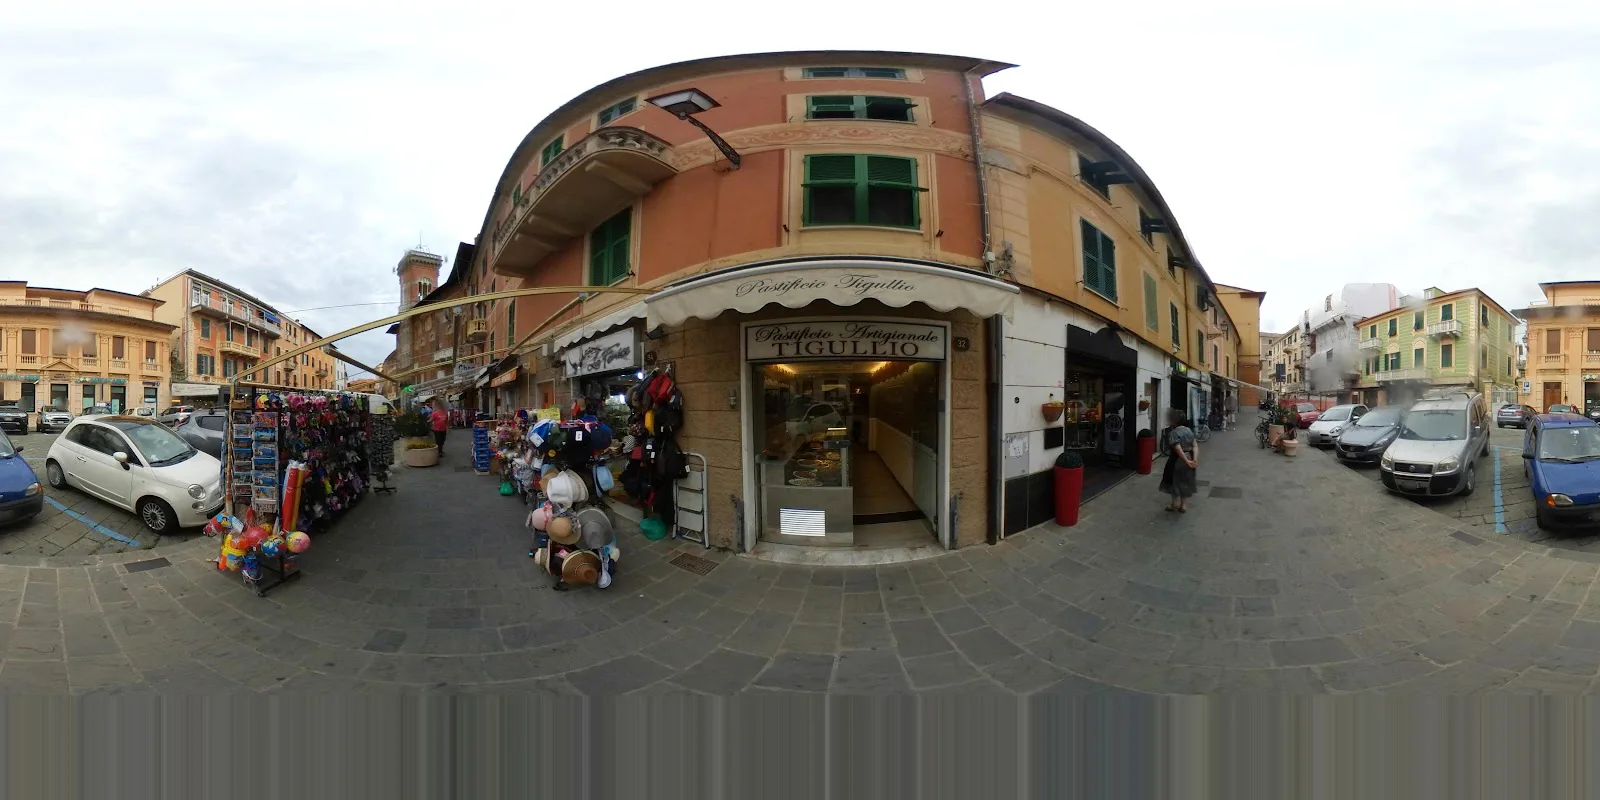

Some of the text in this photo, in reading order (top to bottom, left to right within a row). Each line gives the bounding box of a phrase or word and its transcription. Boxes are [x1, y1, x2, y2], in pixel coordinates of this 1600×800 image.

[735, 273, 916, 298] Pastificio Tigullio
[755, 323, 939, 346] Pastificio Artigianale
[957, 339, 966, 348] 32
[771, 341, 919, 357] TIGULLIO
